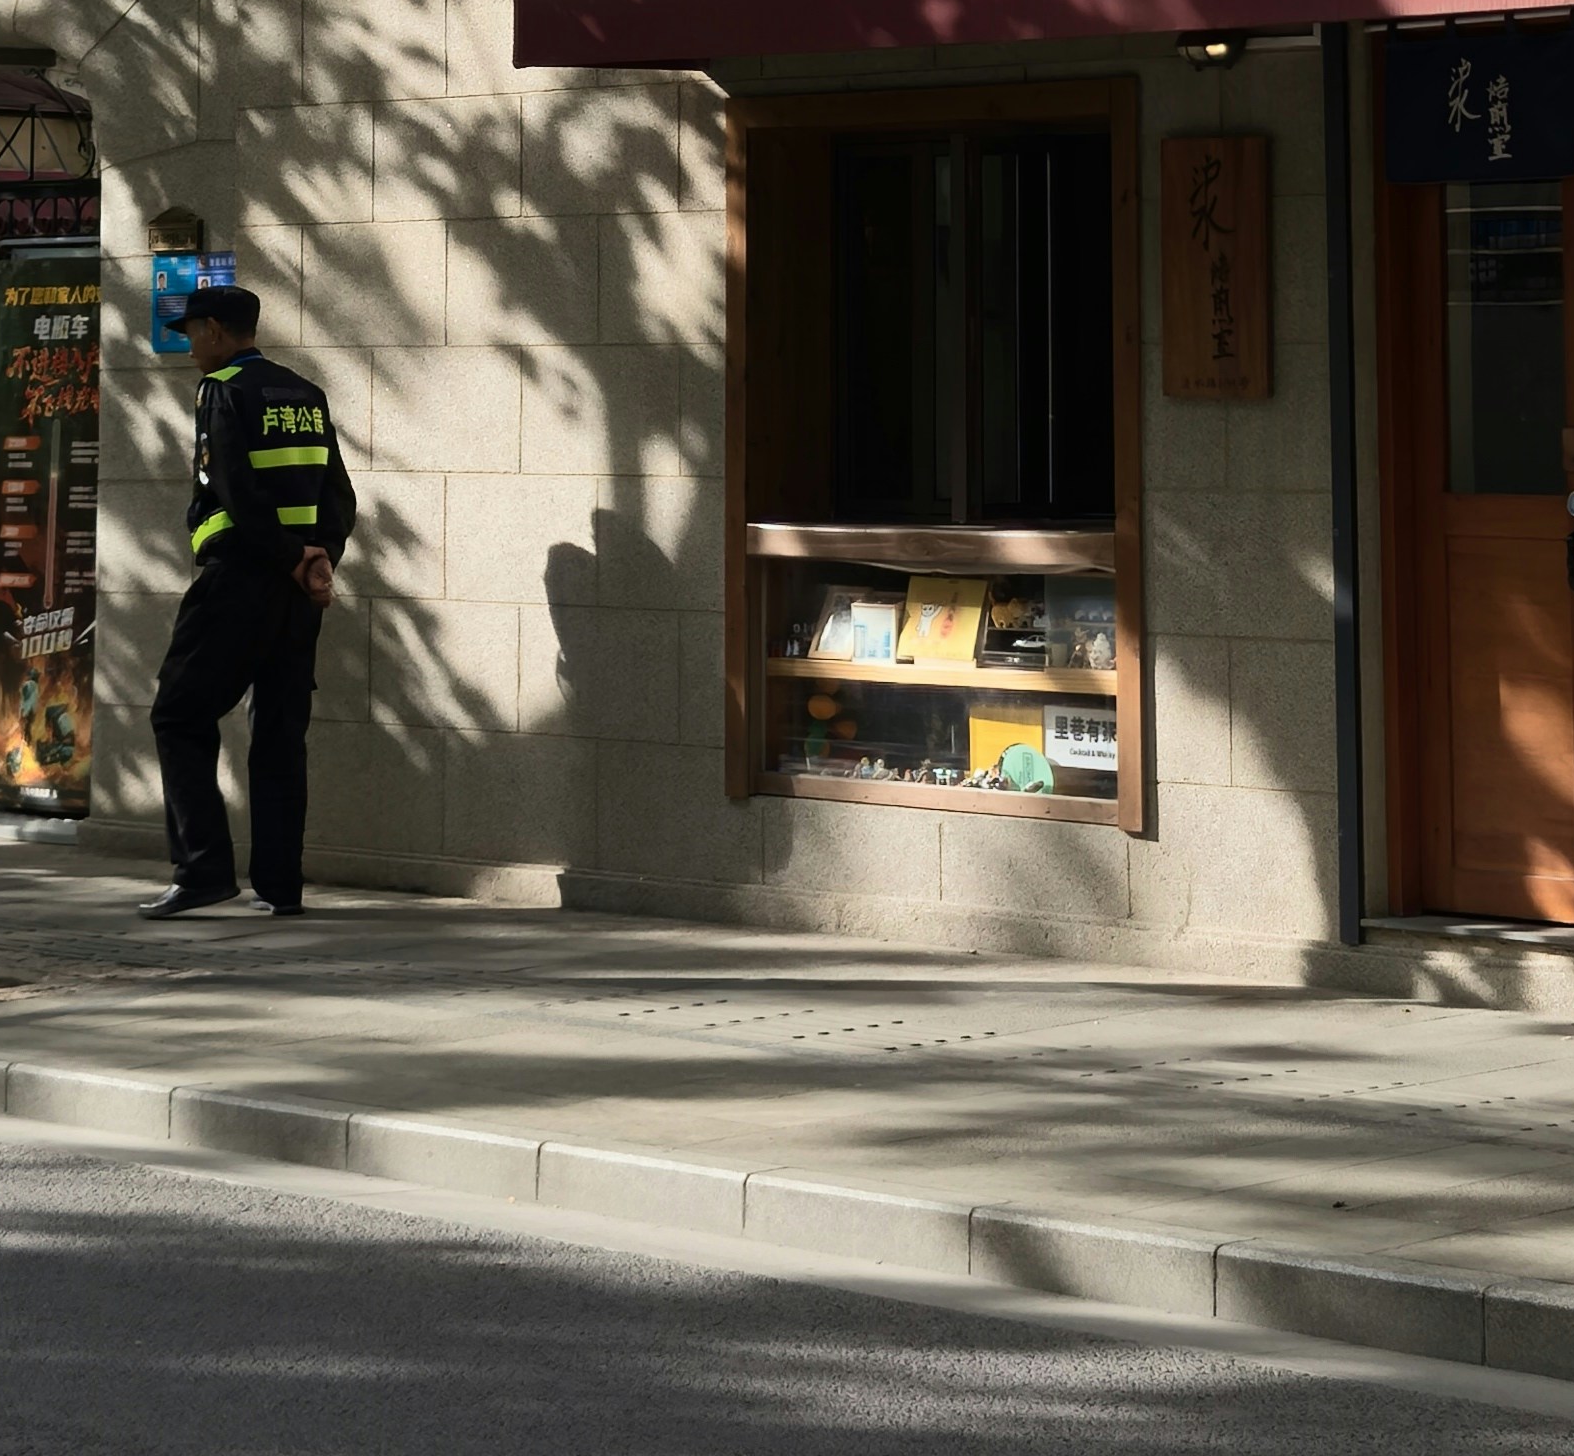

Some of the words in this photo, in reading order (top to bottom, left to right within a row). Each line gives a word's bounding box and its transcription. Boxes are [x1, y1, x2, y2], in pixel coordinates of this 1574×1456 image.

[4, 285, 100, 307] 为了您和家人的
